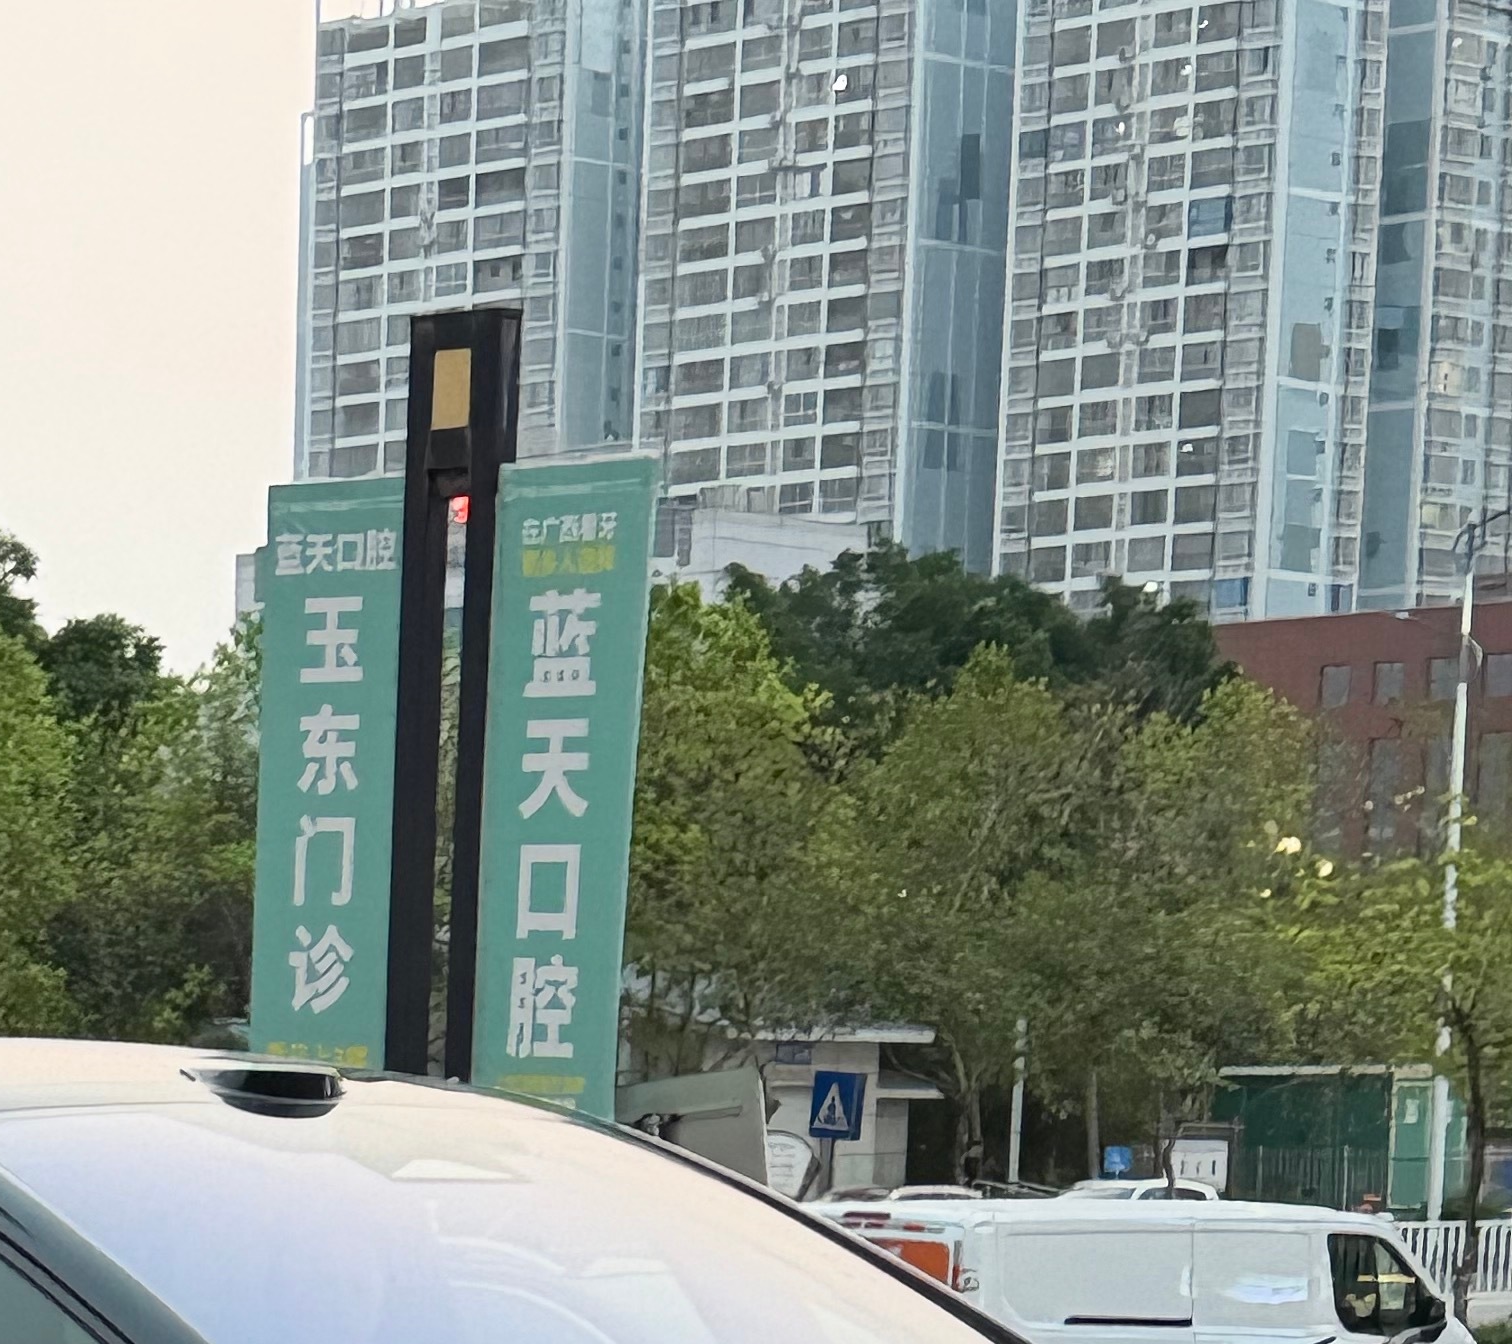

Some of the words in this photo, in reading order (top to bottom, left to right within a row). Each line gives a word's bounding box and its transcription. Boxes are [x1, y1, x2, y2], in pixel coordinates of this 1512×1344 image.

[288, 596, 365, 1015] 玉东门诊
[505, 588, 602, 1060] 蓝天口腔
